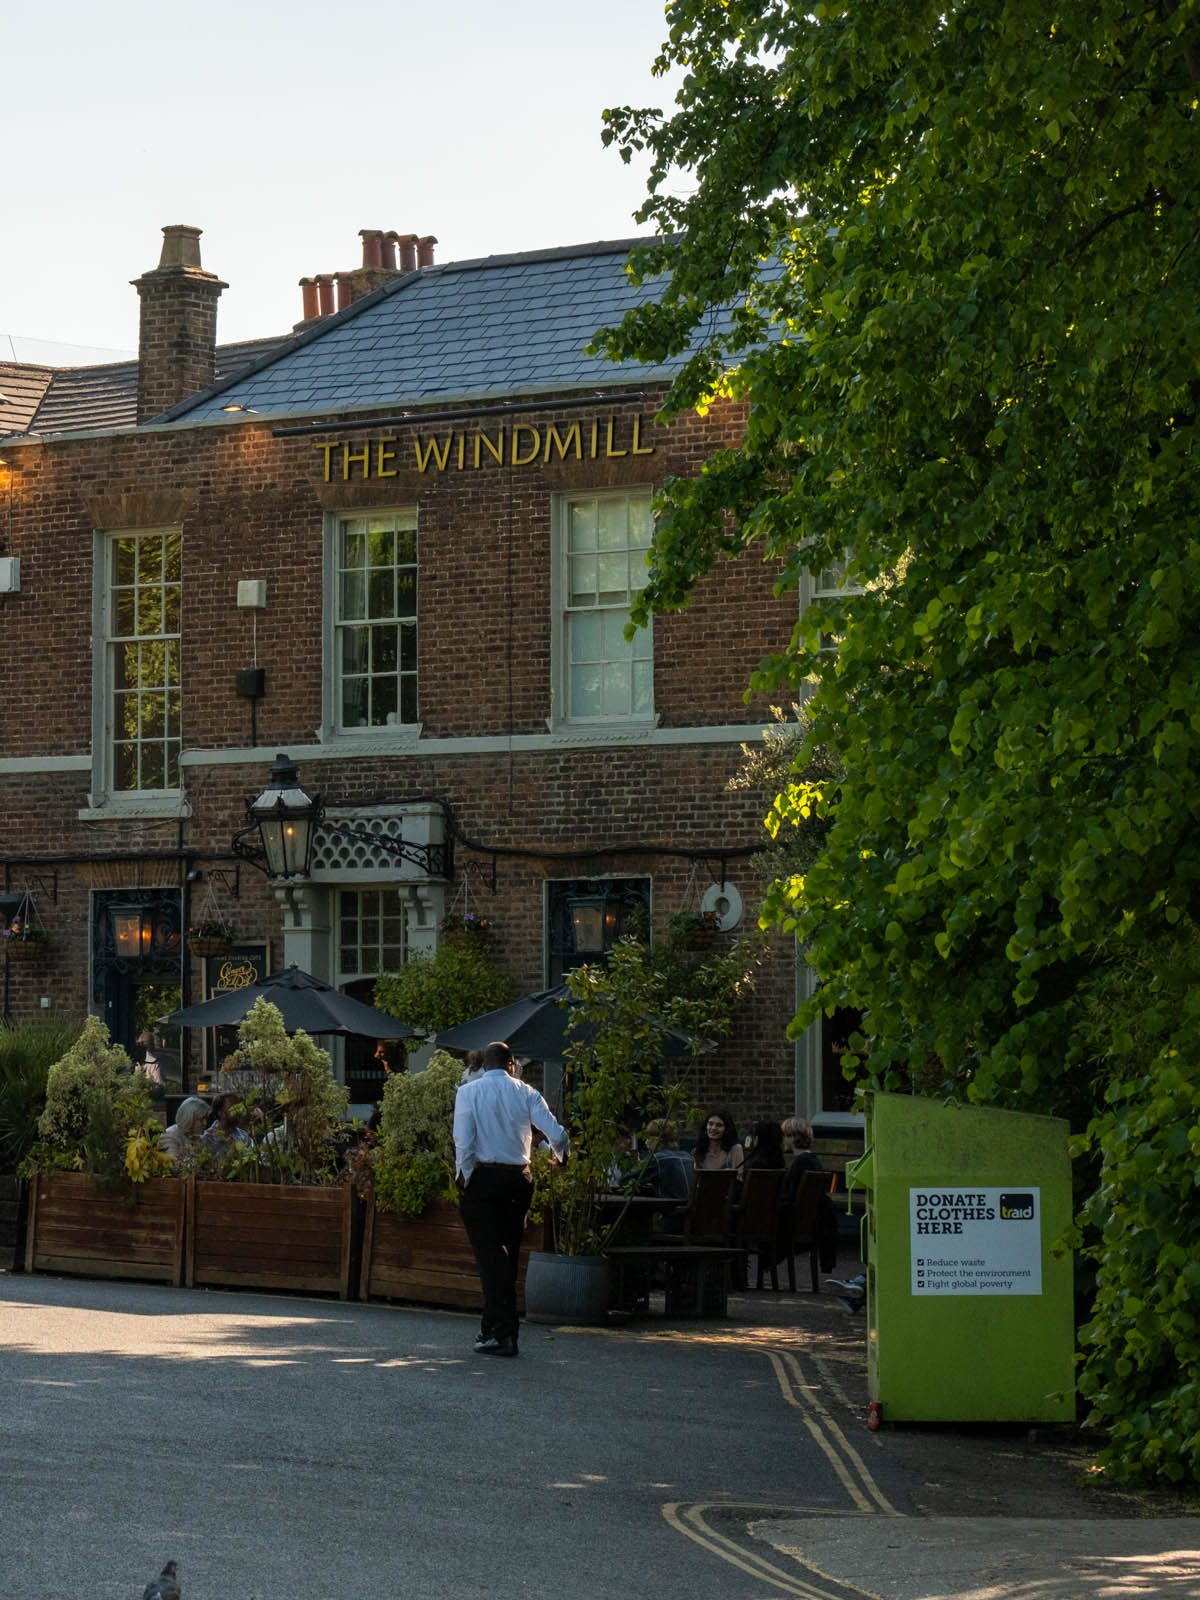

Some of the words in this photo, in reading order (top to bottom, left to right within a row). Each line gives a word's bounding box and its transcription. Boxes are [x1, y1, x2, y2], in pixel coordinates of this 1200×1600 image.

[315, 436, 398, 482] THE
[414, 413, 656, 473] WINDMILL
[916, 1194, 987, 1207] DONATE
[916, 1208, 995, 1220] CLOTHES
[1002, 1206, 1033, 1219] traid
[917, 1222, 964, 1234] HERE
[927, 1259, 959, 1267] Reduce
[927, 1270, 957, 1278] Protect
[959, 1270, 973, 1278] the
[975, 1270, 1031, 1278] environment
[927, 1281, 950, 1289] Fight
[952, 1281, 977, 1289] global
[979, 1281, 1013, 1289] poverty
